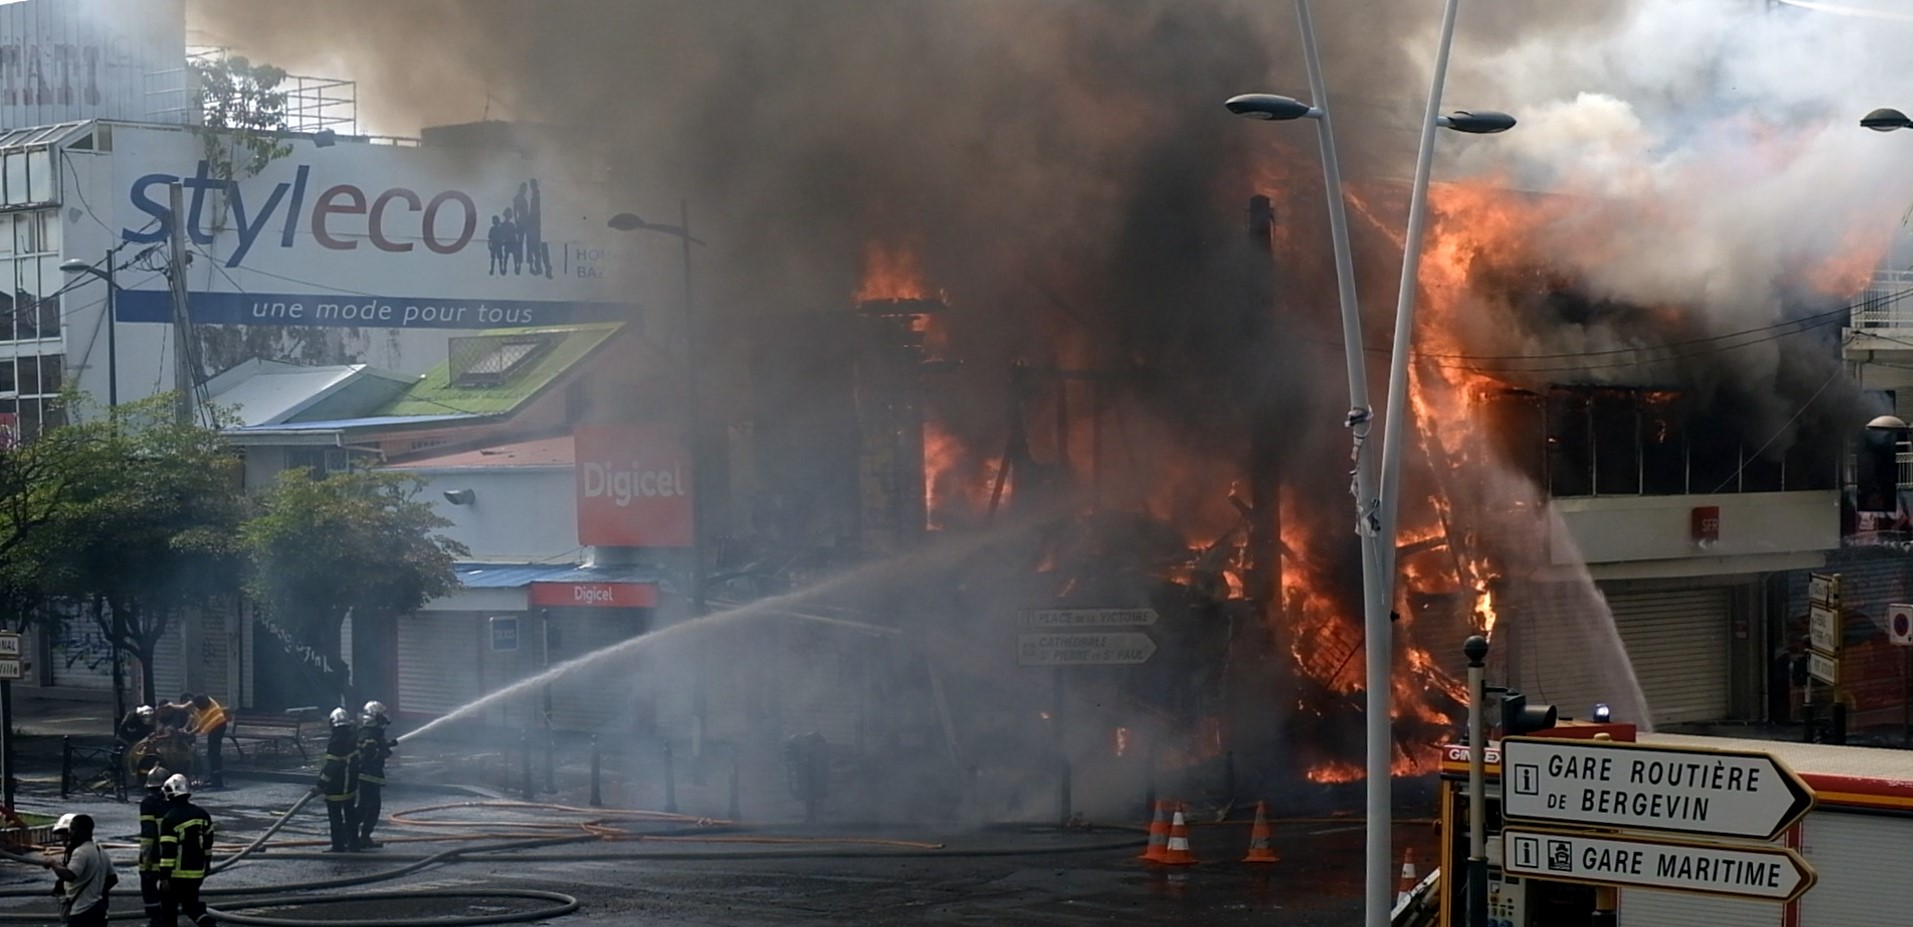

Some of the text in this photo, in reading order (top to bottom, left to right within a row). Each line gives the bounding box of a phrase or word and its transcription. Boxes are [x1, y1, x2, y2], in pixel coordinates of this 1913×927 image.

[122, 160, 477, 268] styleco
[252, 300, 534, 326] une mode pour tous
[584, 461, 685, 507] Digicel
[574, 586, 614, 604] Digicel
[1038, 612, 1073, 624] PLACE
[1100, 611, 1149, 624] VICTOIRE
[0, 639, 16, 652] NAL
[1548, 754, 1760, 792] GARE ROUTIÈRE
[1547, 788, 1709, 821] DE BERGEVIN
[1582, 847, 1781, 888] GARE MARITIME
